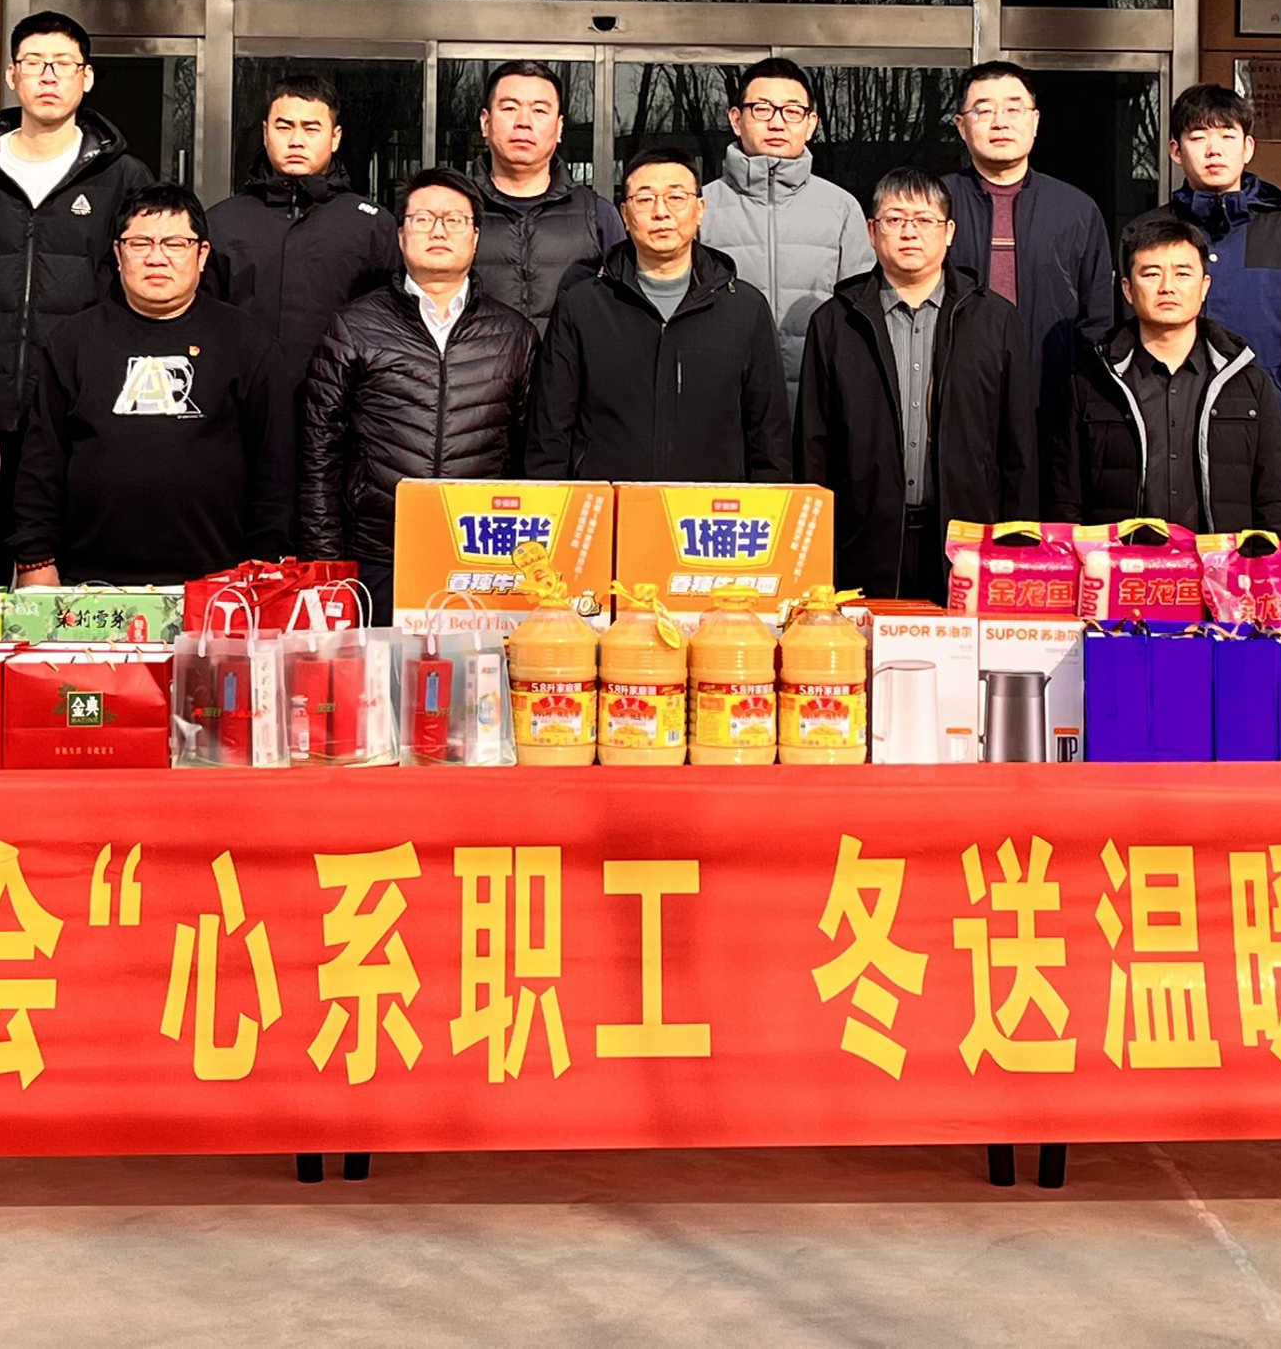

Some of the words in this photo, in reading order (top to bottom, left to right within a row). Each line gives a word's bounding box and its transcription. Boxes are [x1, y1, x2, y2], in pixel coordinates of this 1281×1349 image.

[680, 517, 771, 558] 1桶半
[988, 578, 1075, 607] 金龙鱼
[1119, 577, 1201, 606] 金龙鱼
[55, 609, 126, 630] 茉莉雪芽
[879, 625, 931, 637] SUPOR
[935, 626, 973, 638] 苏泊尔
[985, 628, 1038, 640] SUPOR
[1040, 629, 1080, 641] 苏泊尔
[70, 695, 100, 717] 金典
